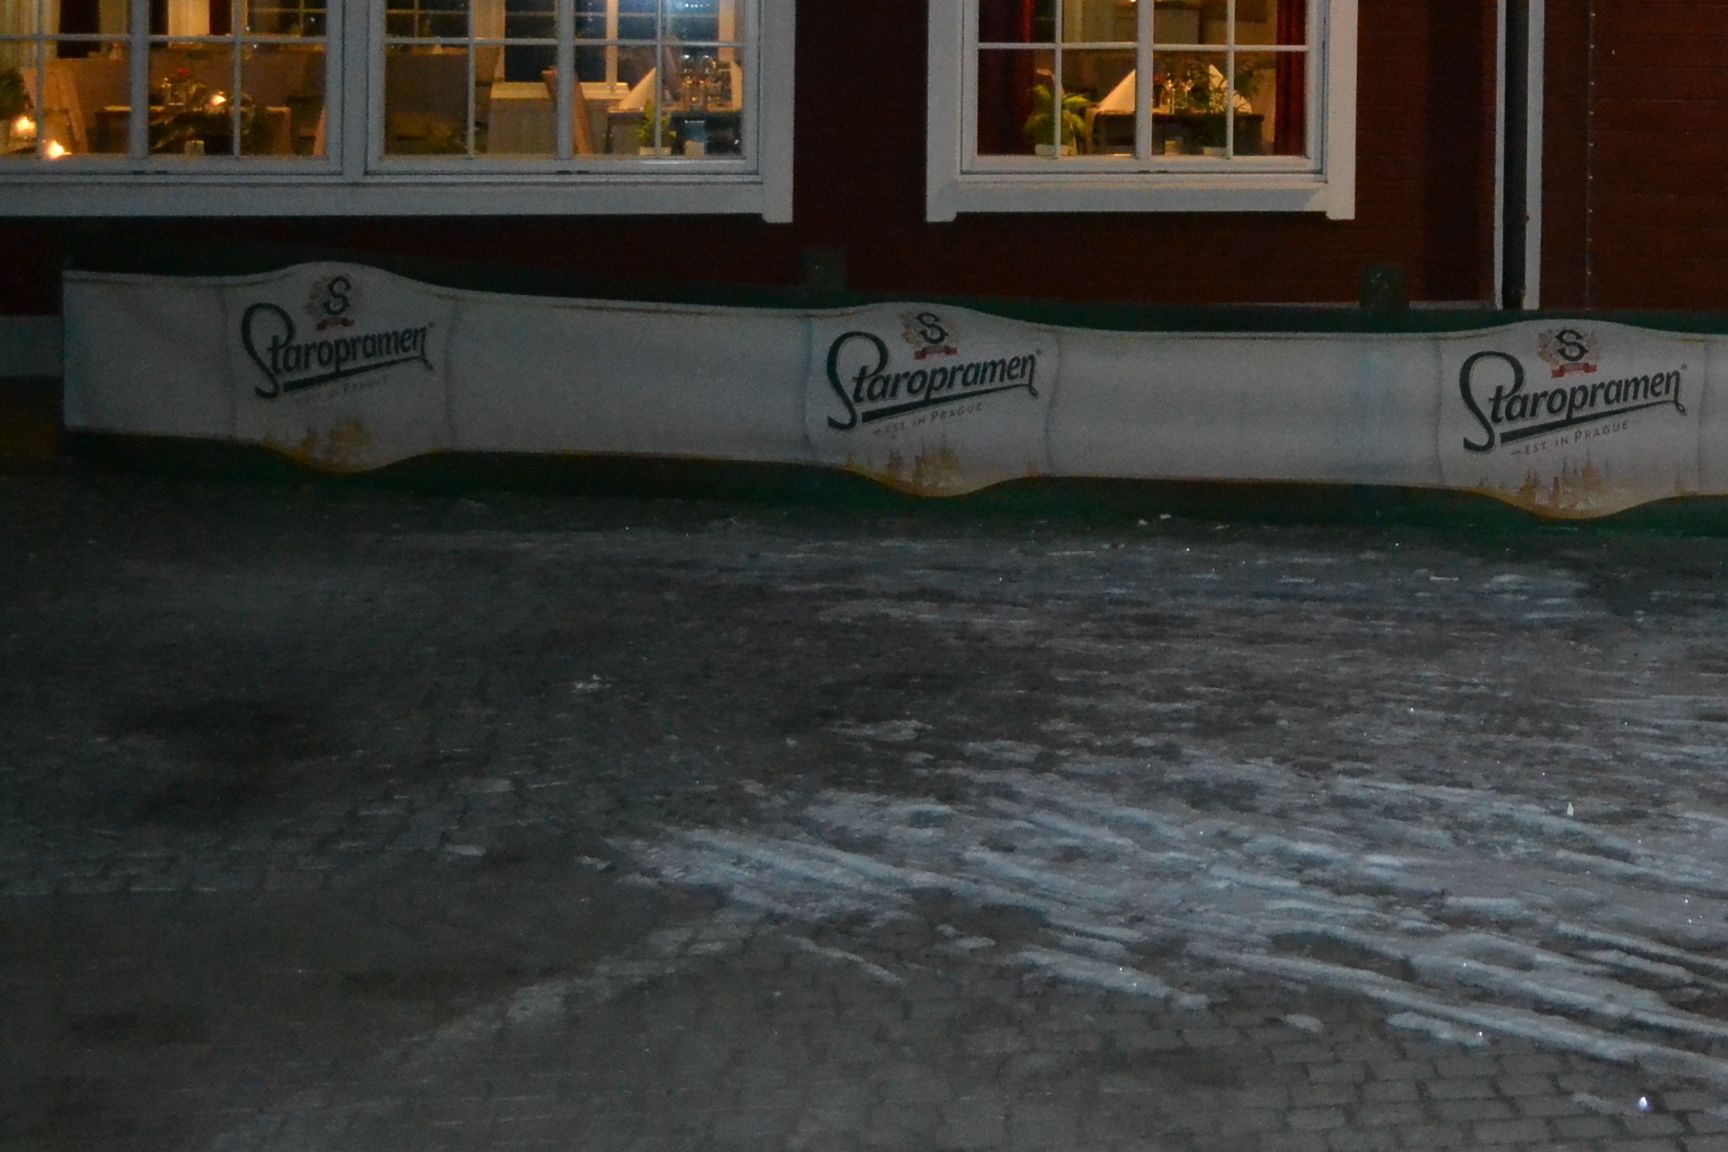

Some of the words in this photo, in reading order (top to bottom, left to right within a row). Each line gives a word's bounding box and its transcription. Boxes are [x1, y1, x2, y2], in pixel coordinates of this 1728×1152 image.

[242, 302, 433, 400] Staropramen
[827, 330, 1039, 431] Staropramen
[1459, 350, 1687, 453] Staropramen
[1574, 420, 1629, 443] PRAGUE
